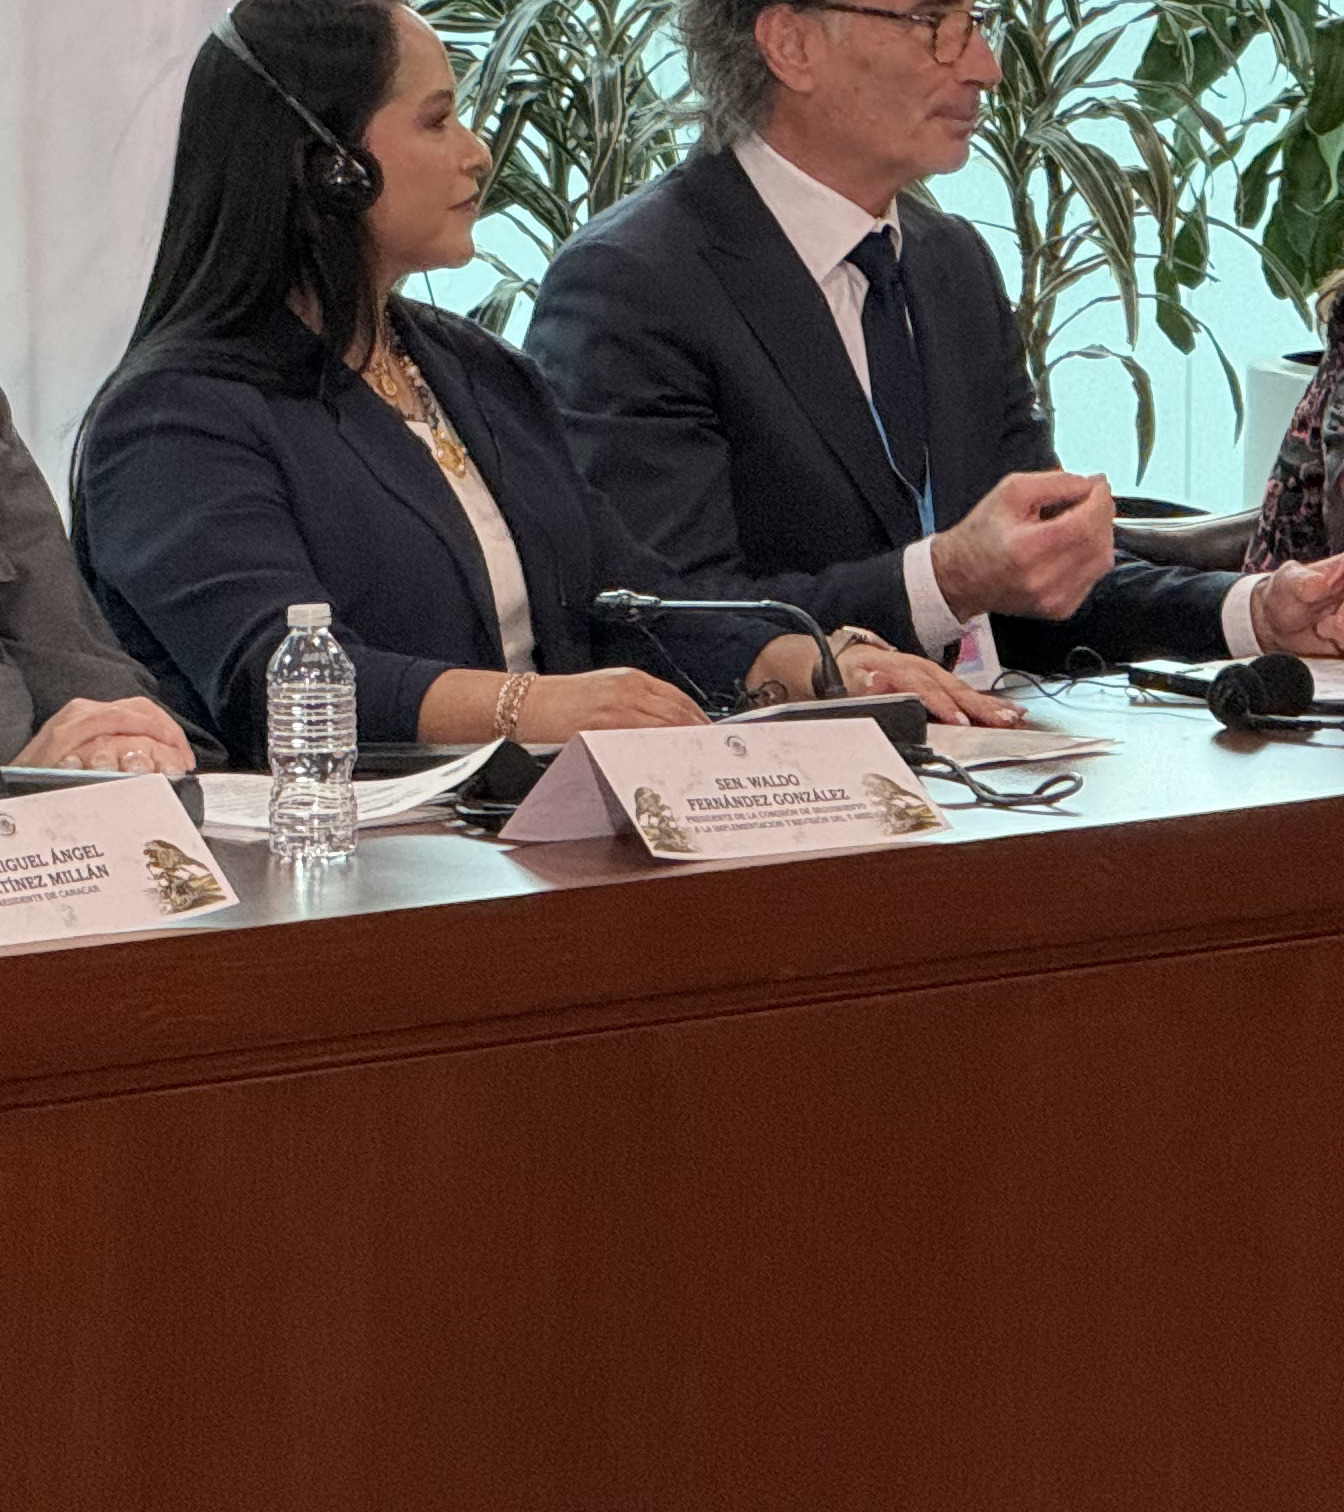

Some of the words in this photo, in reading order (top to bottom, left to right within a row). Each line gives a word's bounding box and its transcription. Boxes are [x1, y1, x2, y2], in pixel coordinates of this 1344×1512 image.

[746, 773, 800, 789] WALDO
[686, 794, 772, 811] FERNÁNDEZ
[773, 787, 850, 806] GONZÁLEZ
[50, 844, 105, 865] ÁNGEL
[47, 864, 110, 886] MILLÁN
